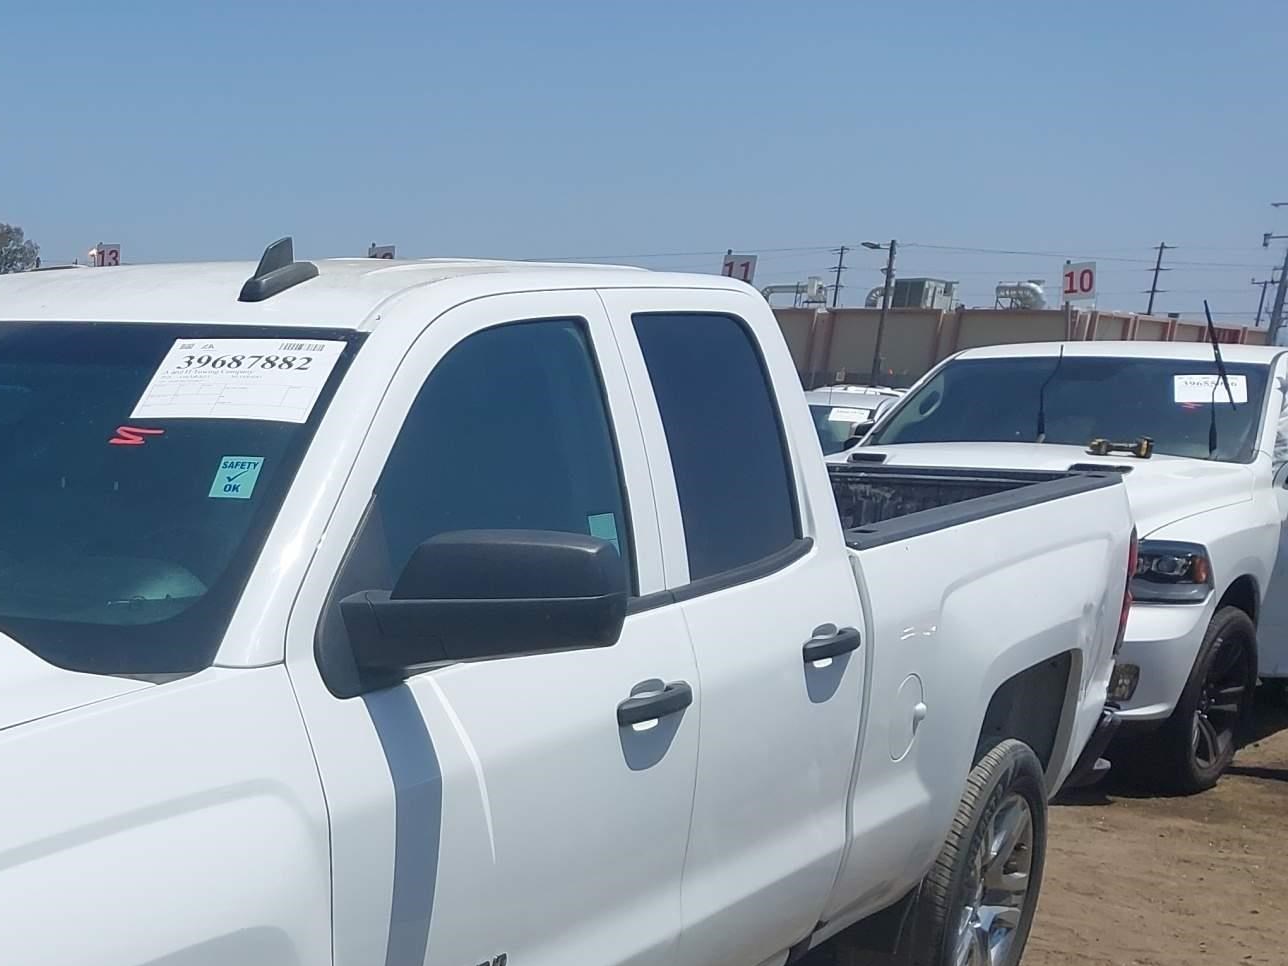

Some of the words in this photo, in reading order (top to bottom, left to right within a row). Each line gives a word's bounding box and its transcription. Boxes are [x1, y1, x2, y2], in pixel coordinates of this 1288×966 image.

[97, 249, 119, 266] 13
[724, 261, 750, 281] 11
[1064, 269, 1094, 294] 10
[176, 354, 313, 371] 39687882
[222, 461, 259, 470] SAFETY
[223, 484, 241, 493] OK
